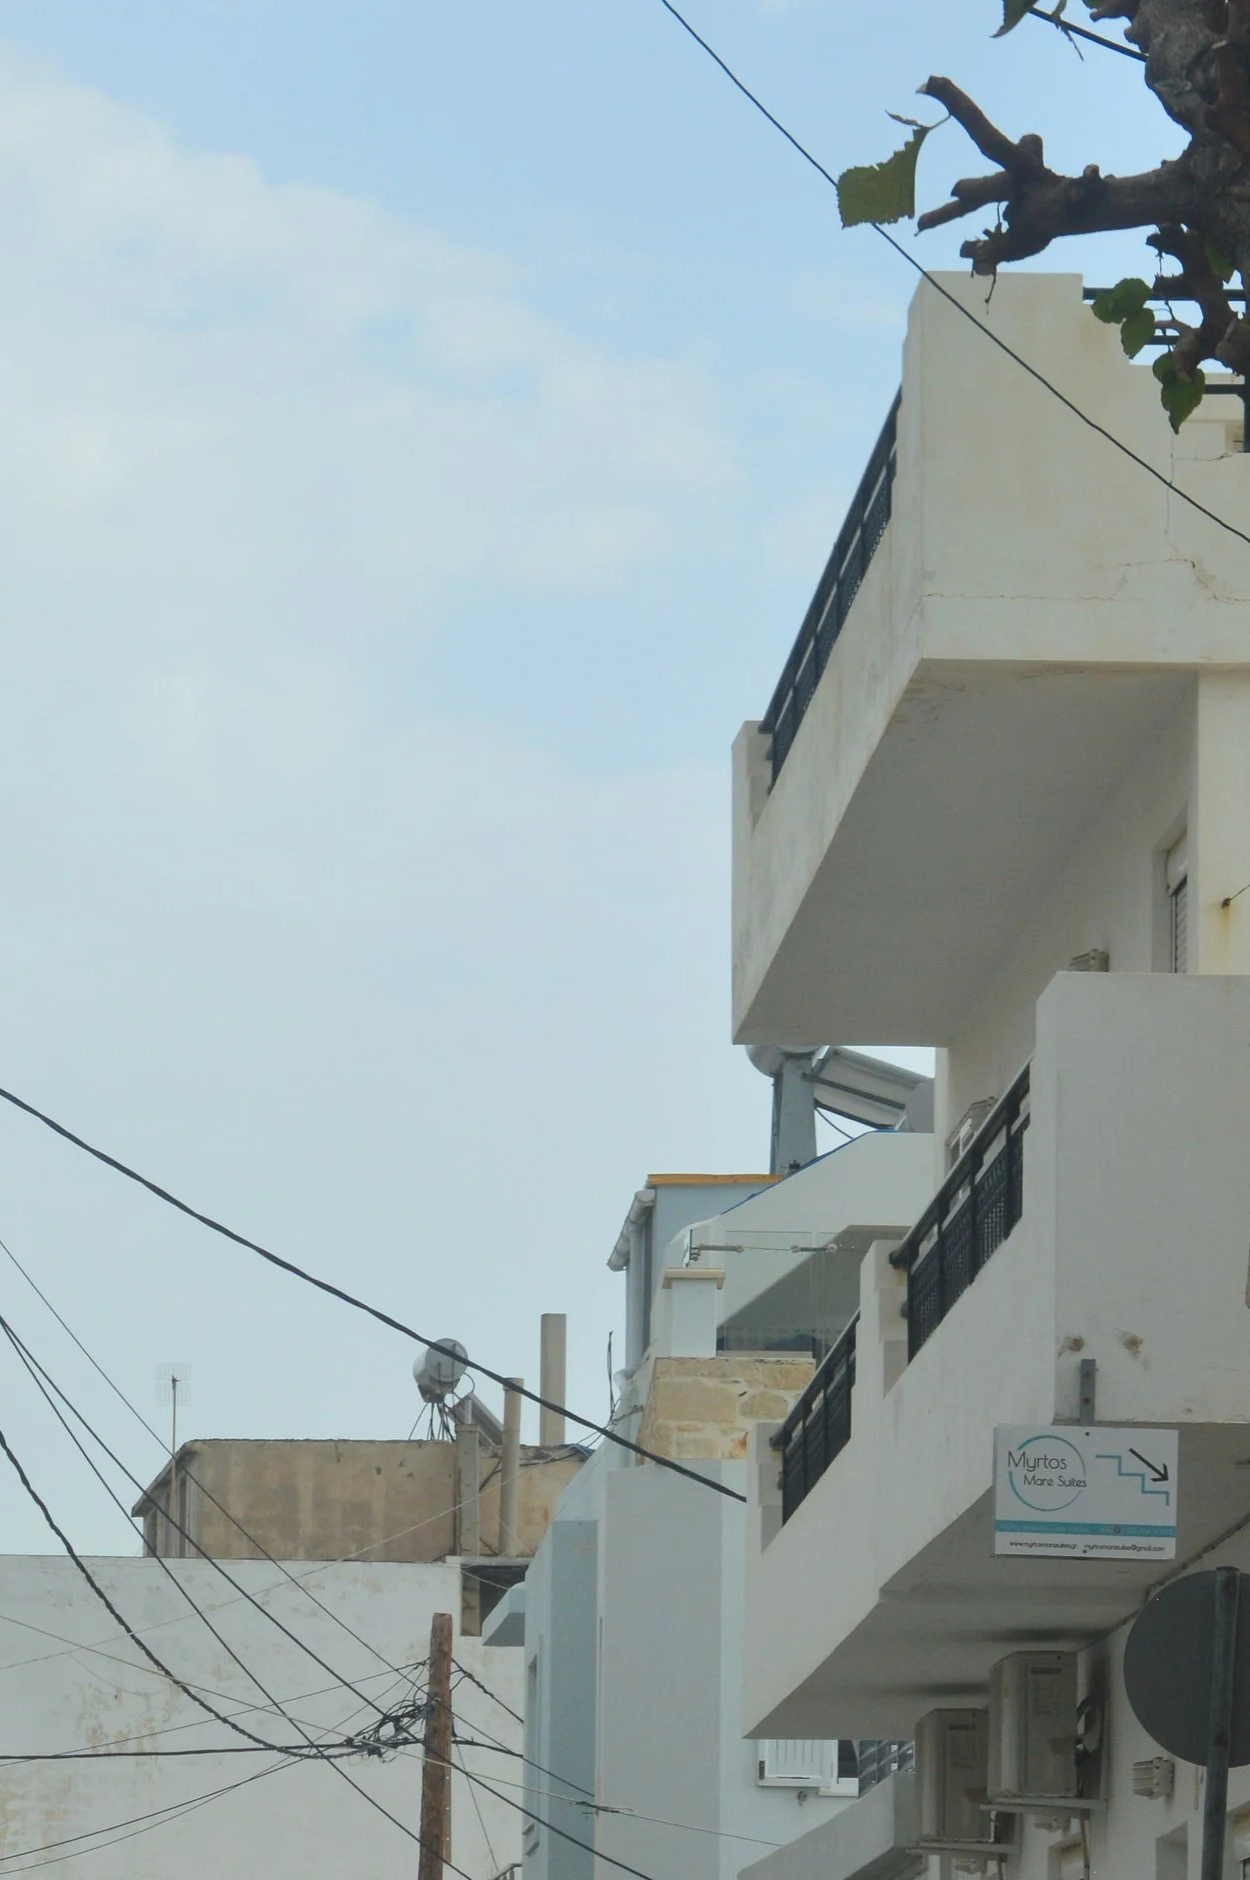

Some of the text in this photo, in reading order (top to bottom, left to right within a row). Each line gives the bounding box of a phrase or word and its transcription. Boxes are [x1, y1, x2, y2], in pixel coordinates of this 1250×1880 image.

[1007, 1450, 1068, 1473] Myrtos
[1023, 1475, 1087, 1488] Mare Suites
